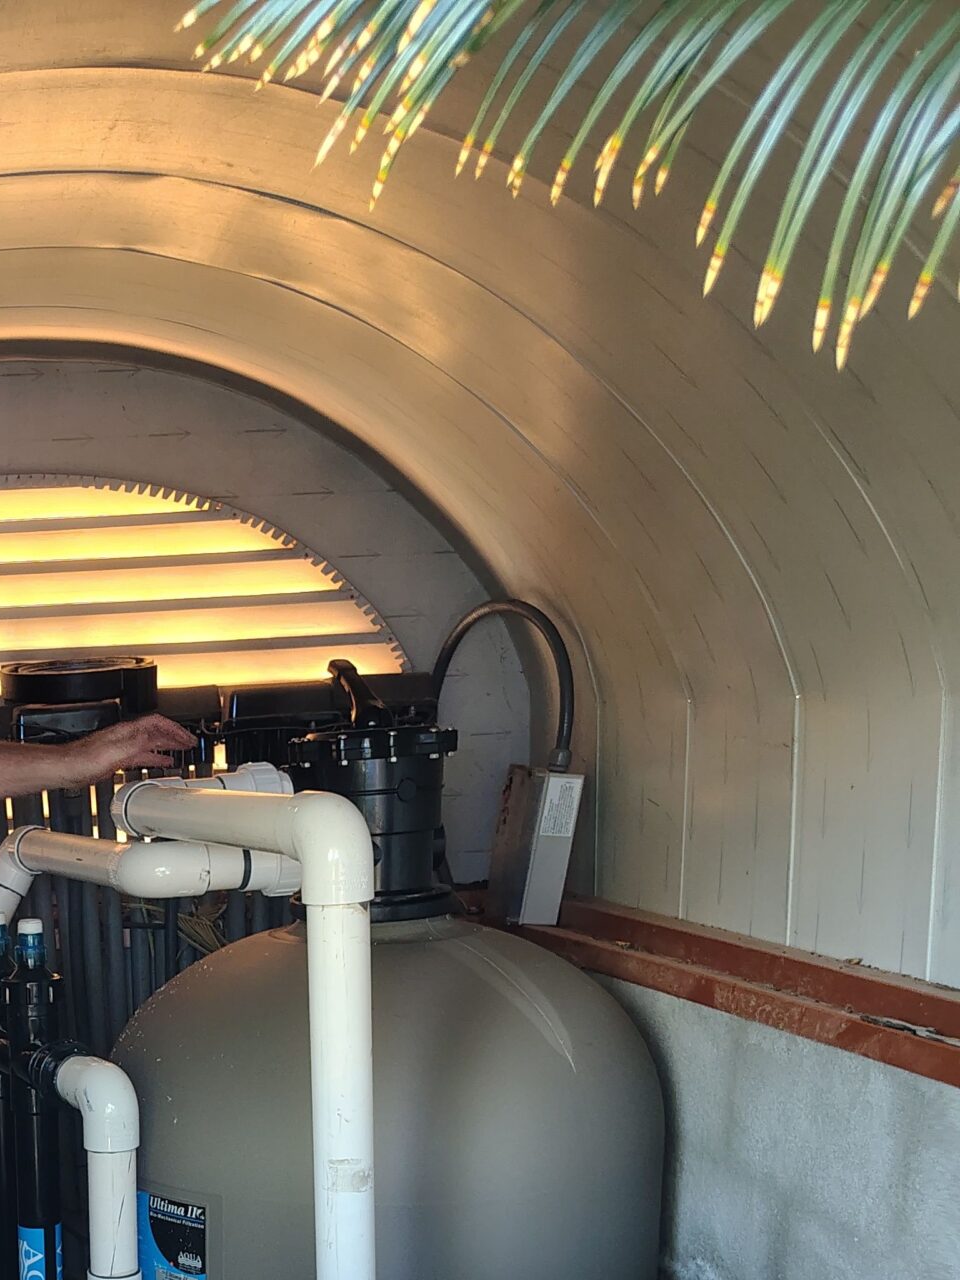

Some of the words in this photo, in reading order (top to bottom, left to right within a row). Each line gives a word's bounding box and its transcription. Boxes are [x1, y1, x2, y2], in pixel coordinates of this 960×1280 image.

[149, 1196, 186, 1217] Ultima
[149, 1210, 182, 1224] Bio-Mechanical
[182, 1219, 205, 1230] Filtration
[177, 1250, 202, 1266] AQUA
